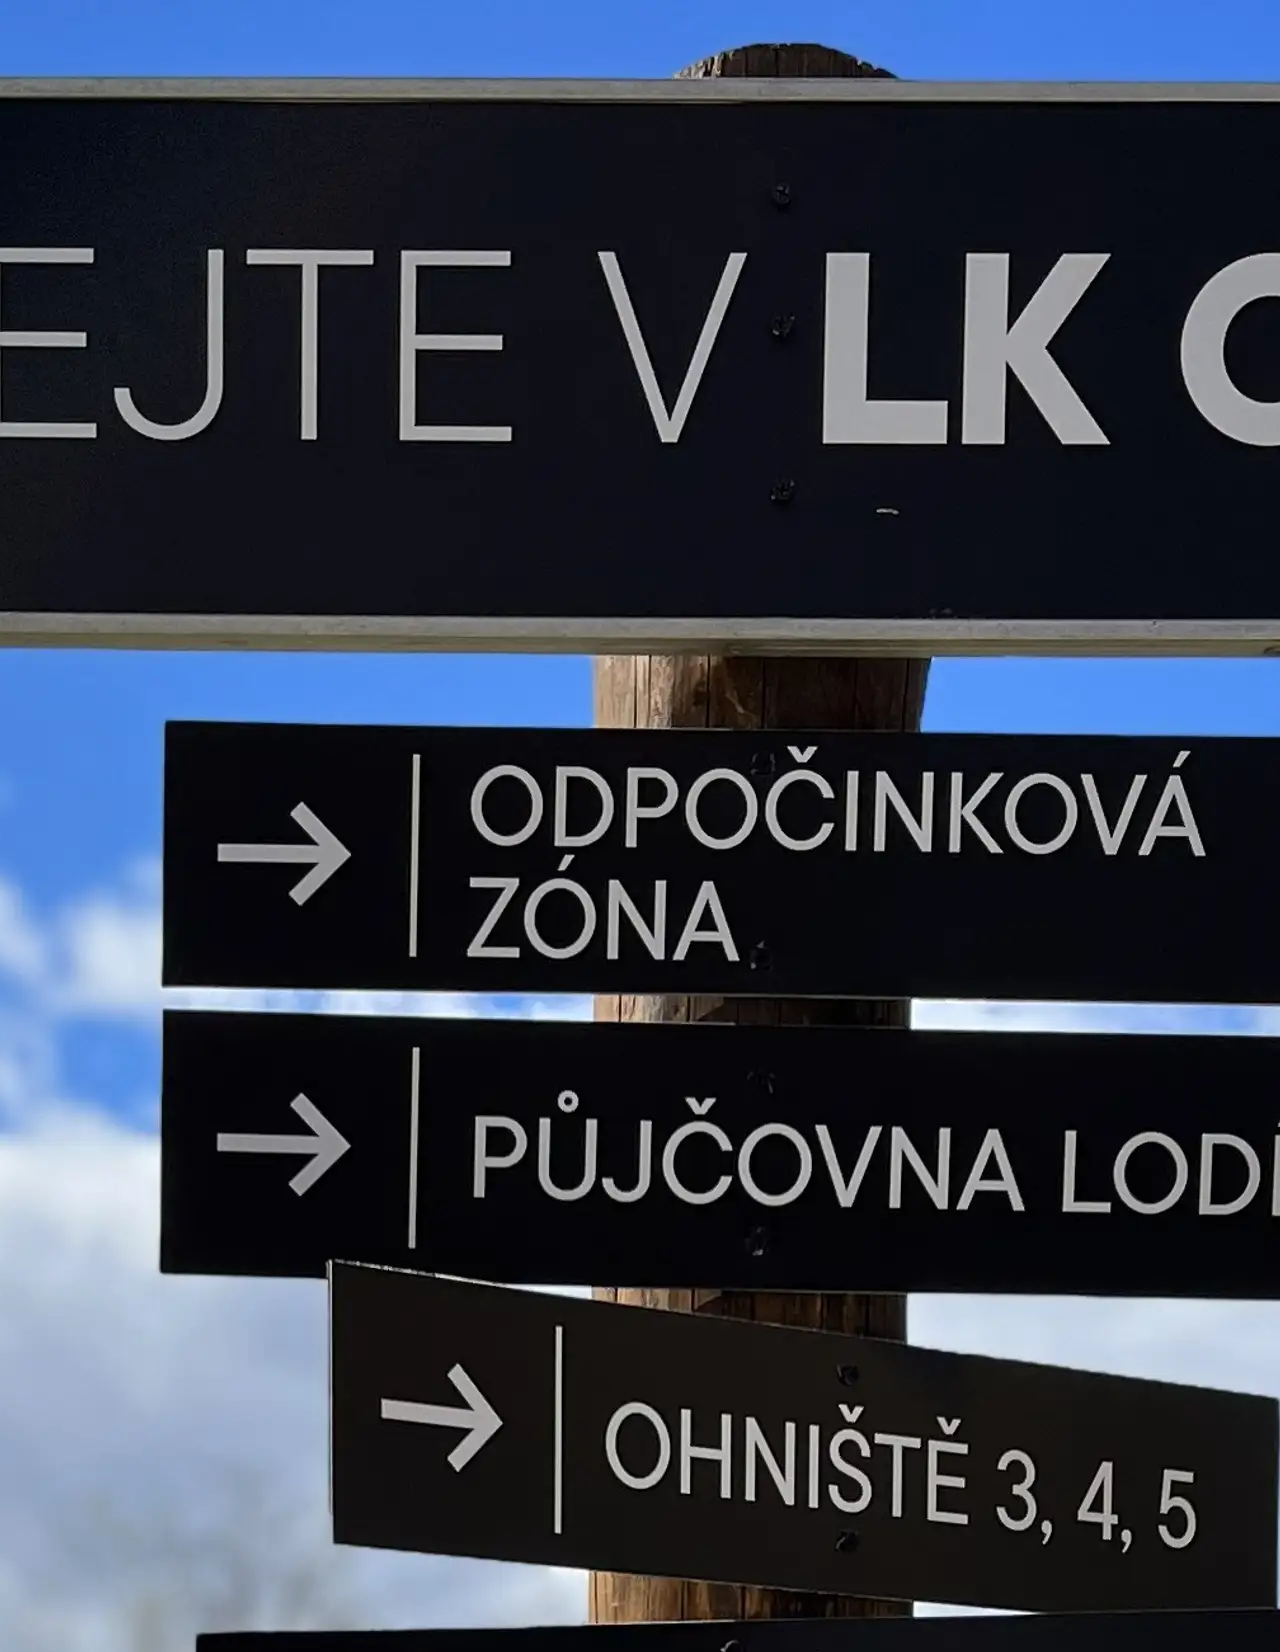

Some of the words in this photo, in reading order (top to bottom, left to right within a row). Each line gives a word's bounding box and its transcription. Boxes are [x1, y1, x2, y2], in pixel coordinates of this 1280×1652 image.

[596, 250, 749, 445] V
[821, 251, 1113, 446] LK
[469, 744, 1207, 858] ODPOČINKOVÁ
[465, 853, 742, 963] ZÓNA
[472, 1088, 1027, 1213] PŮJČOVNA
[604, 1400, 970, 1526] OHNIŠTĚ
[995, 1448, 1054, 1546] 3,
[1076, 1460, 1133, 1555] 4,
[1156, 1467, 1198, 1550] 5
